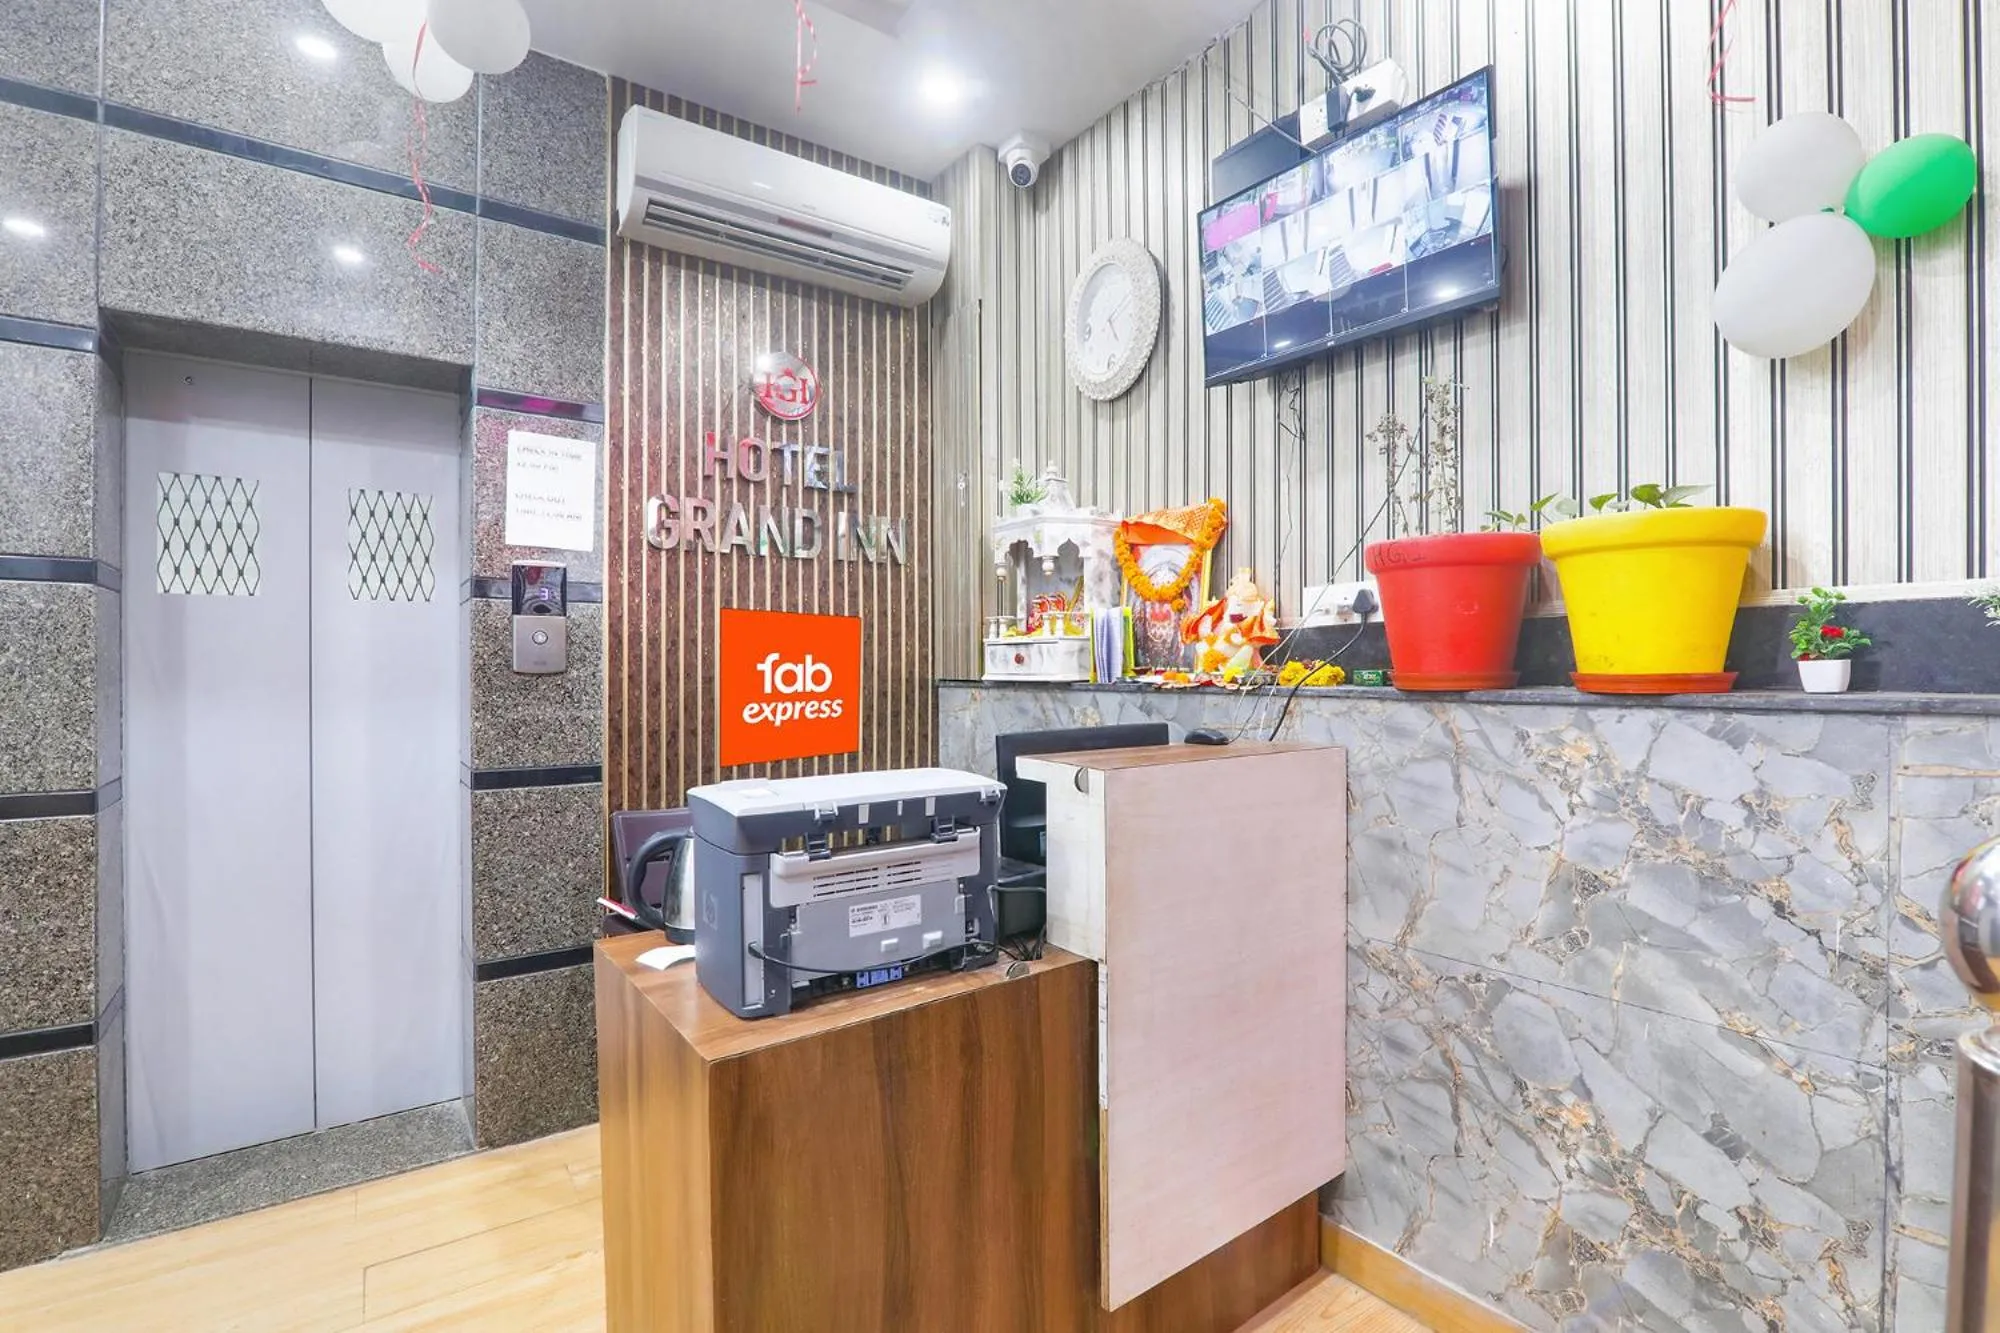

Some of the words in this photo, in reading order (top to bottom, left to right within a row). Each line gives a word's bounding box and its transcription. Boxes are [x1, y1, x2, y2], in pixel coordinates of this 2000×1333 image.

[703, 432, 857, 493] HOTEL
[646, 493, 823, 560] GRAND
[836, 511, 907, 565] INN
[756, 652, 833, 695] fab
[742, 698, 844, 727] express
